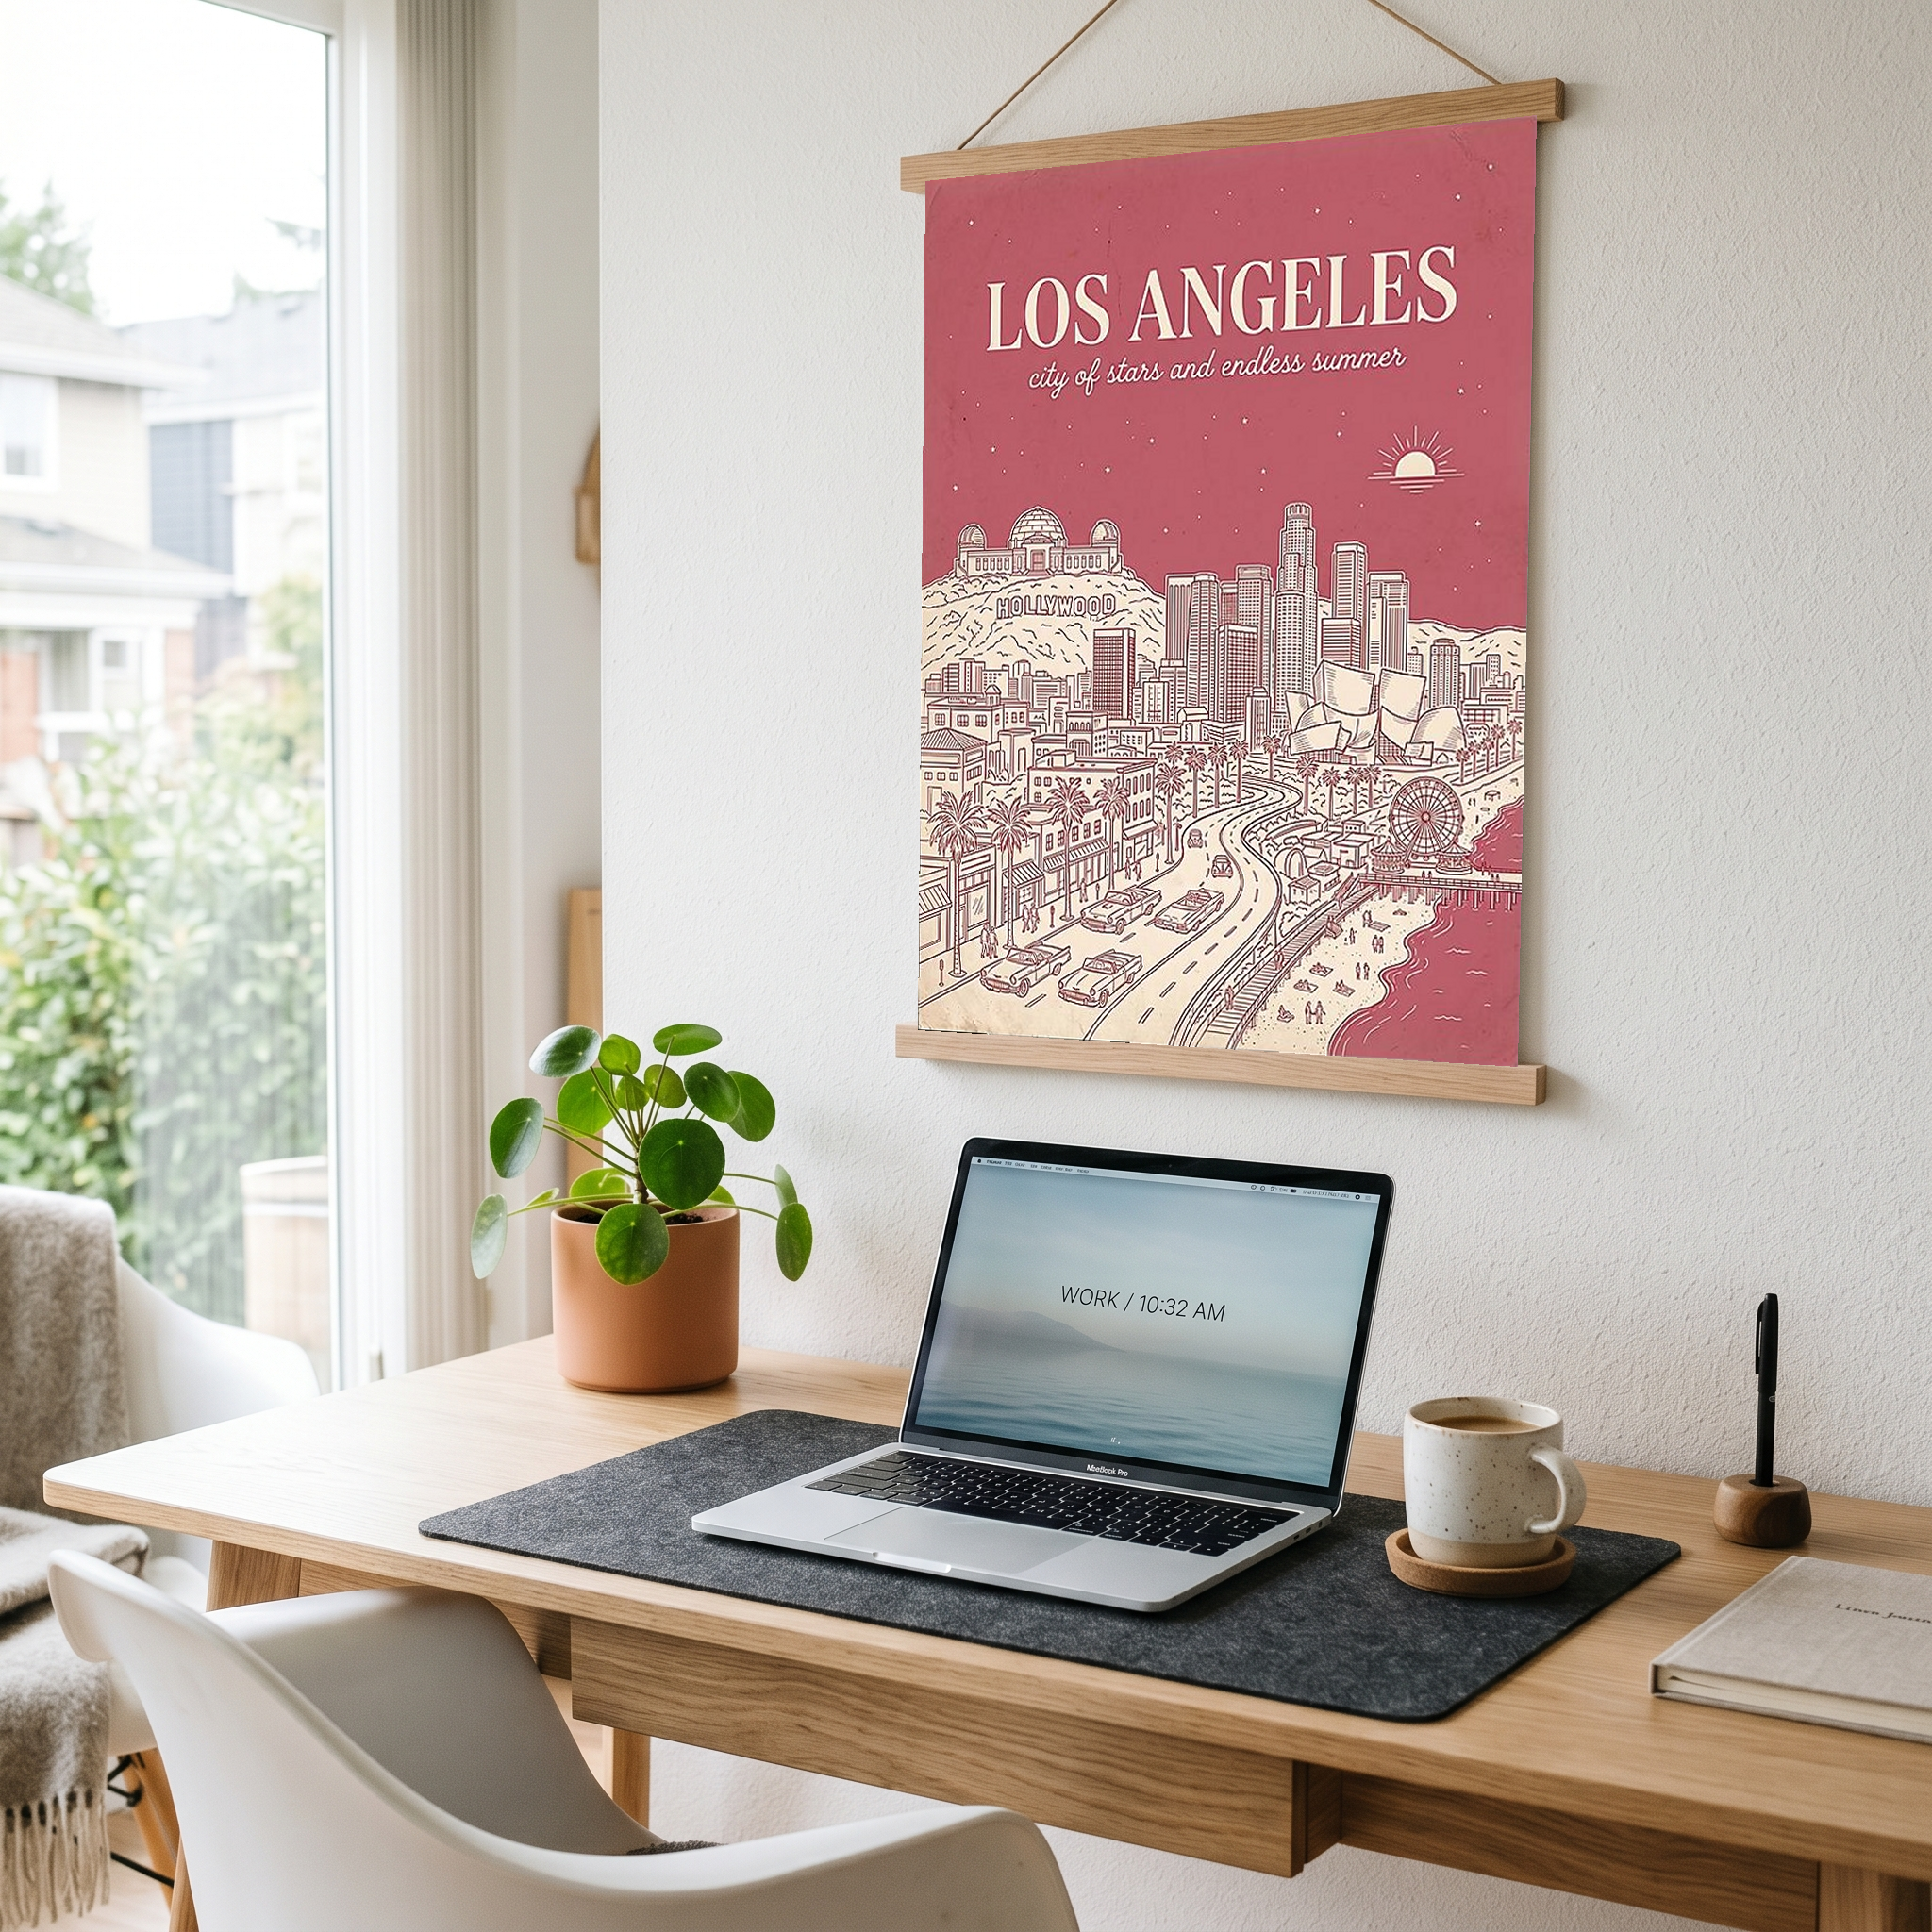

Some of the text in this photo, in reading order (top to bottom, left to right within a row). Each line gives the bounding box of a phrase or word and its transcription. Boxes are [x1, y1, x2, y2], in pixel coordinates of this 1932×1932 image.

[987, 244, 1457, 351] LOS ANGELES
[1028, 345, 1407, 399] city of stars and endless summer
[996, 592, 1116, 619] HOLLYWOOD
[1061, 1285, 1226, 1323] WORK / 10:32 AM
[1117, 1468, 1129, 1477] Pro
